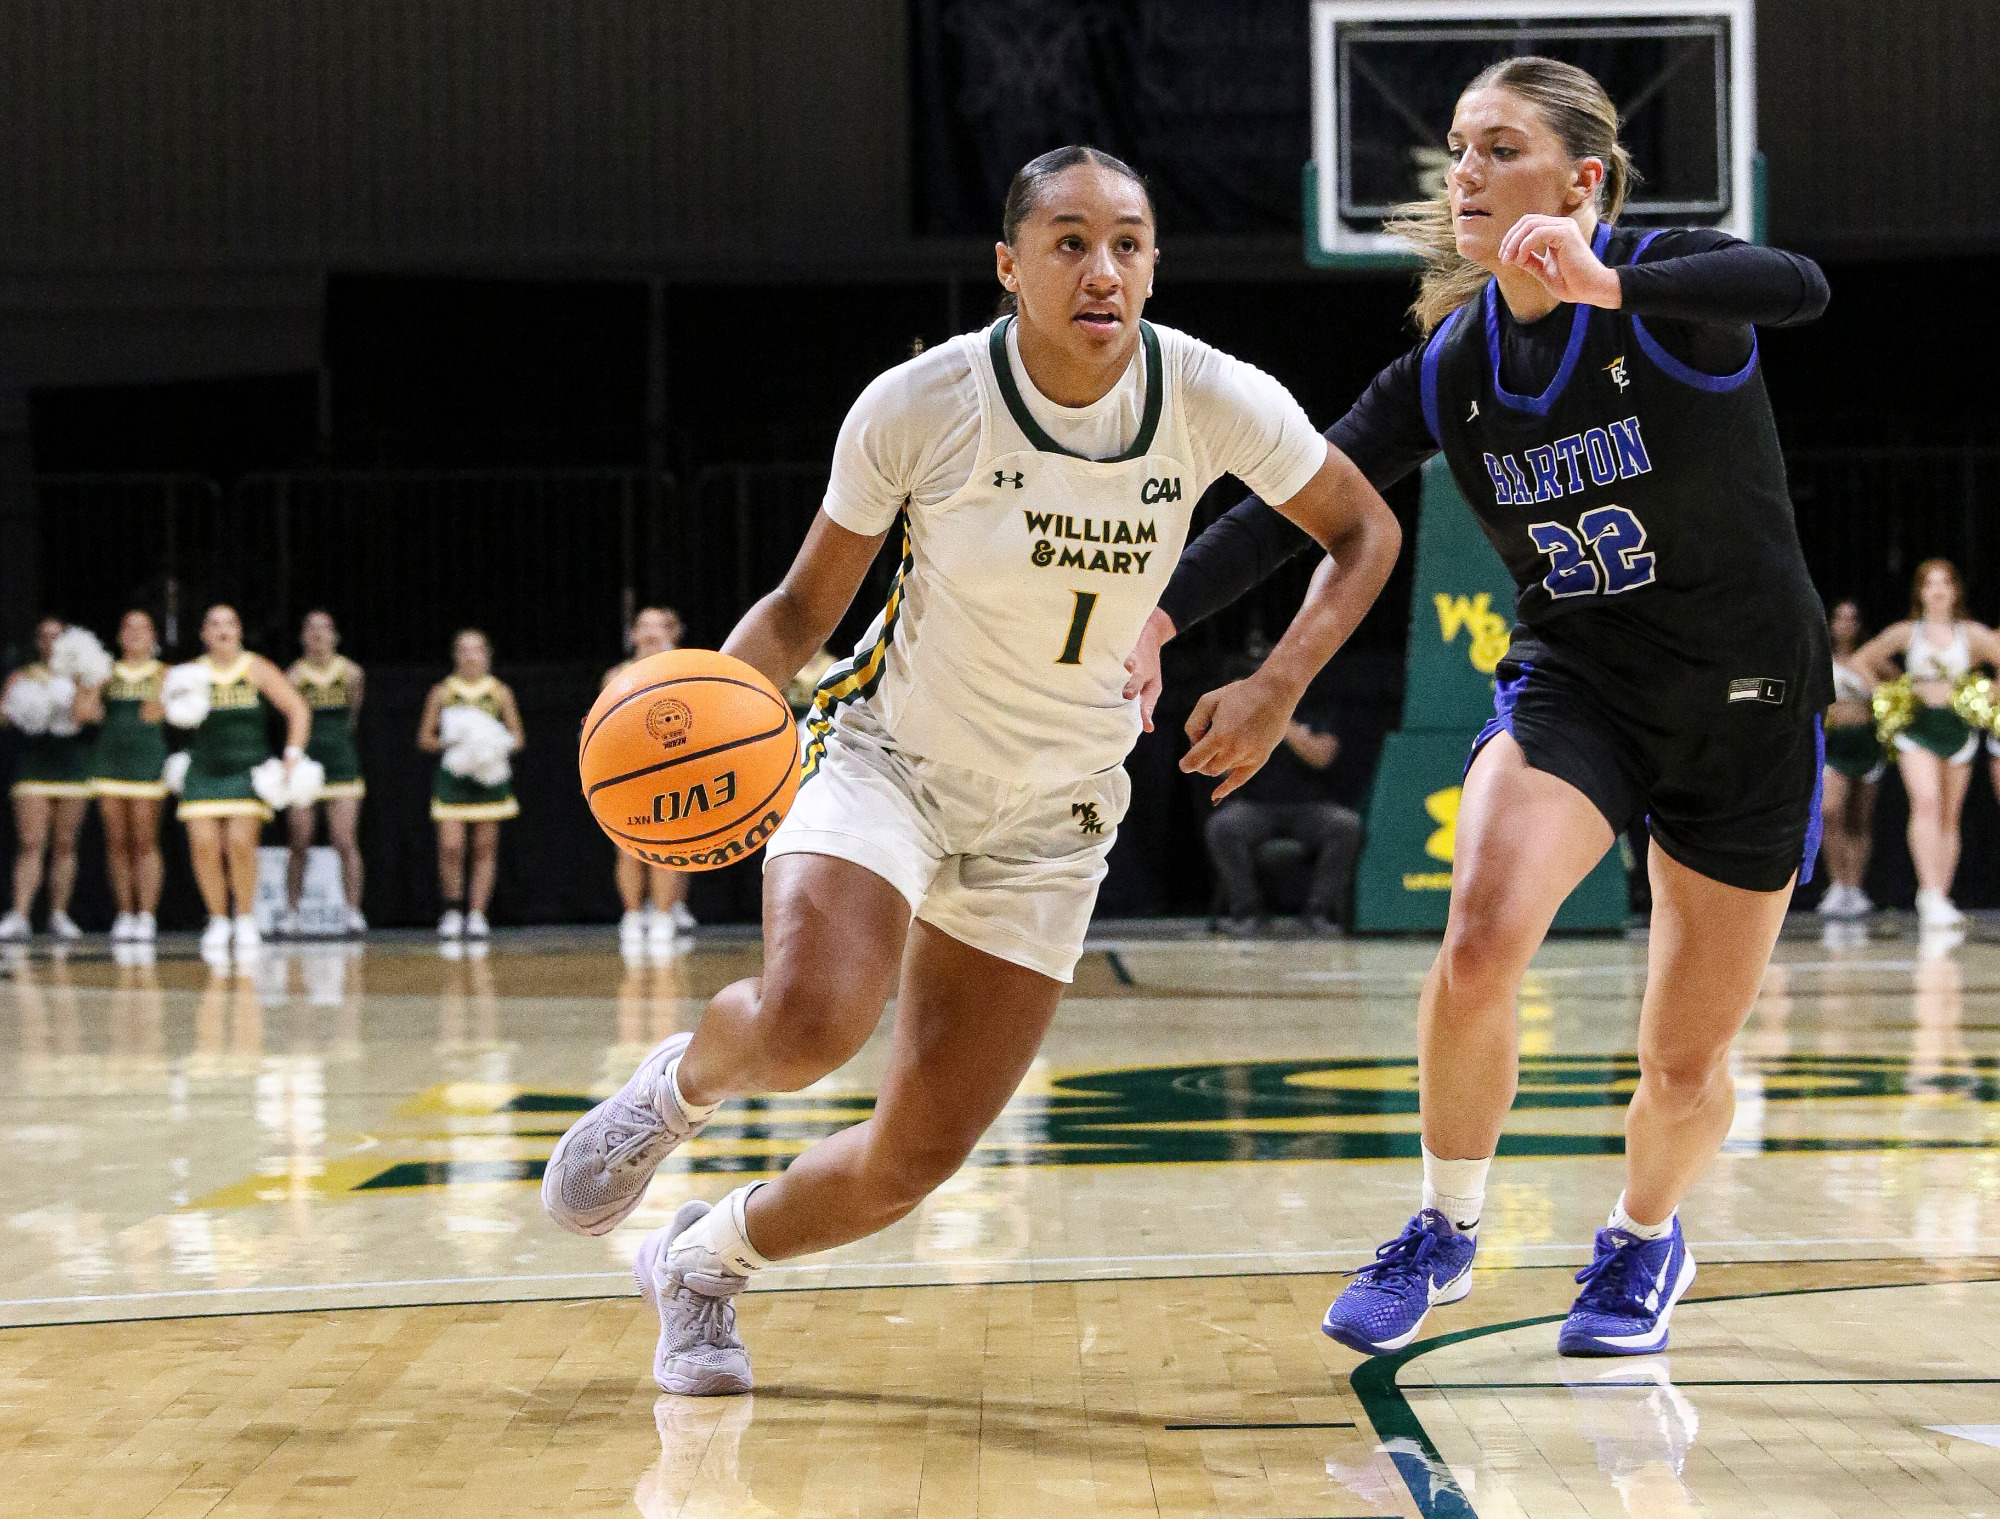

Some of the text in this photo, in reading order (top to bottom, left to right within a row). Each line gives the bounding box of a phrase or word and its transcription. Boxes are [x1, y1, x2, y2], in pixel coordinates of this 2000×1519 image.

[1482, 416, 1653, 505] BARTON
[1140, 477, 1182, 504] CAA
[1022, 510, 1159, 544] WILLIAM
[1527, 503, 1657, 600] 22
[1053, 588, 1100, 665] 1
[1766, 685, 1775, 697] L
[626, 770, 737, 826] EVO NXT
